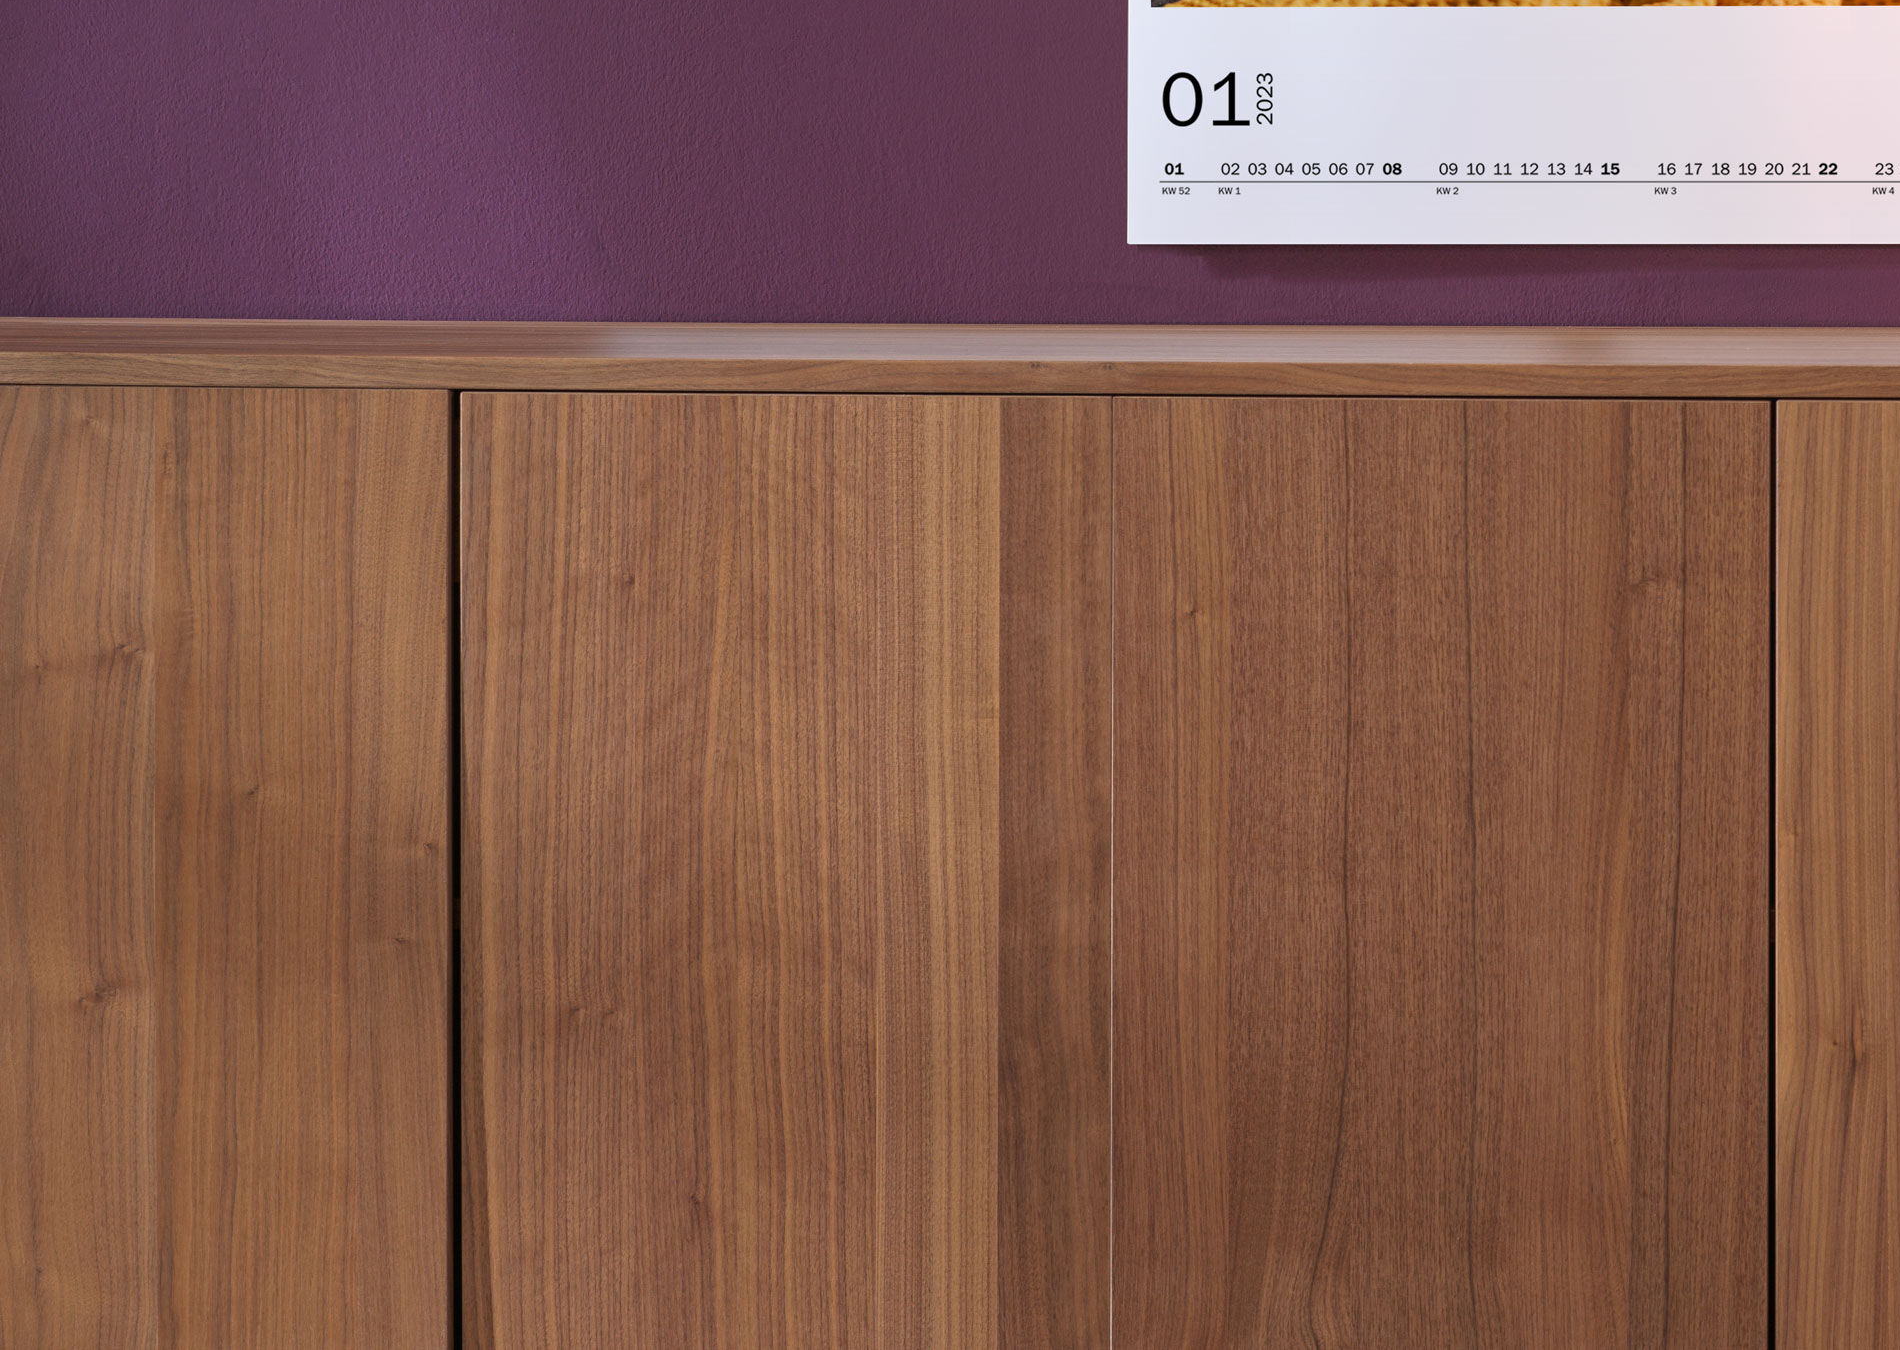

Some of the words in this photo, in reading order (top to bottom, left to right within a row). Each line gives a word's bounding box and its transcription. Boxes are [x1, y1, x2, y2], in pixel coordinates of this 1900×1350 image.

[1162, 71, 1251, 128] 01
[1255, 72, 1275, 126] 2023
[1163, 162, 1185, 176] 01
[1220, 162, 1241, 176] 02
[1247, 162, 1268, 176] 03
[1274, 162, 1295, 176] 04
[1301, 162, 1322, 177] 05
[1328, 162, 1349, 177] 06
[1355, 162, 1375, 176] 07
[1382, 162, 1403, 176] 08
[1438, 162, 1459, 177] 09
[1466, 162, 1486, 176] 10
[1493, 162, 1513, 176] 11
[1520, 162, 1540, 176] 12
[1547, 162, 1567, 177] 13
[1574, 162, 1594, 176] 14
[1600, 162, 1621, 176] 15
[1657, 162, 1677, 176] 16
[1684, 162, 1703, 176] 17
[1711, 162, 1731, 176] 18
[1738, 162, 1758, 176] 19
[1764, 162, 1785, 176] 20
[1791, 162, 1812, 176] 21
[1818, 162, 1839, 176] 22
[1874, 162, 1895, 176] 23
[1161, 186, 1178, 196] KW
[1178, 186, 1191, 196] 52
[1217, 186, 1234, 196] KW
[1435, 186, 1452, 196] KW
[1452, 186, 1460, 196] 2
[1653, 186, 1670, 196] KW
[1670, 186, 1678, 196] 3
[1871, 186, 1888, 196] KW
[1888, 186, 1895, 196] 4
